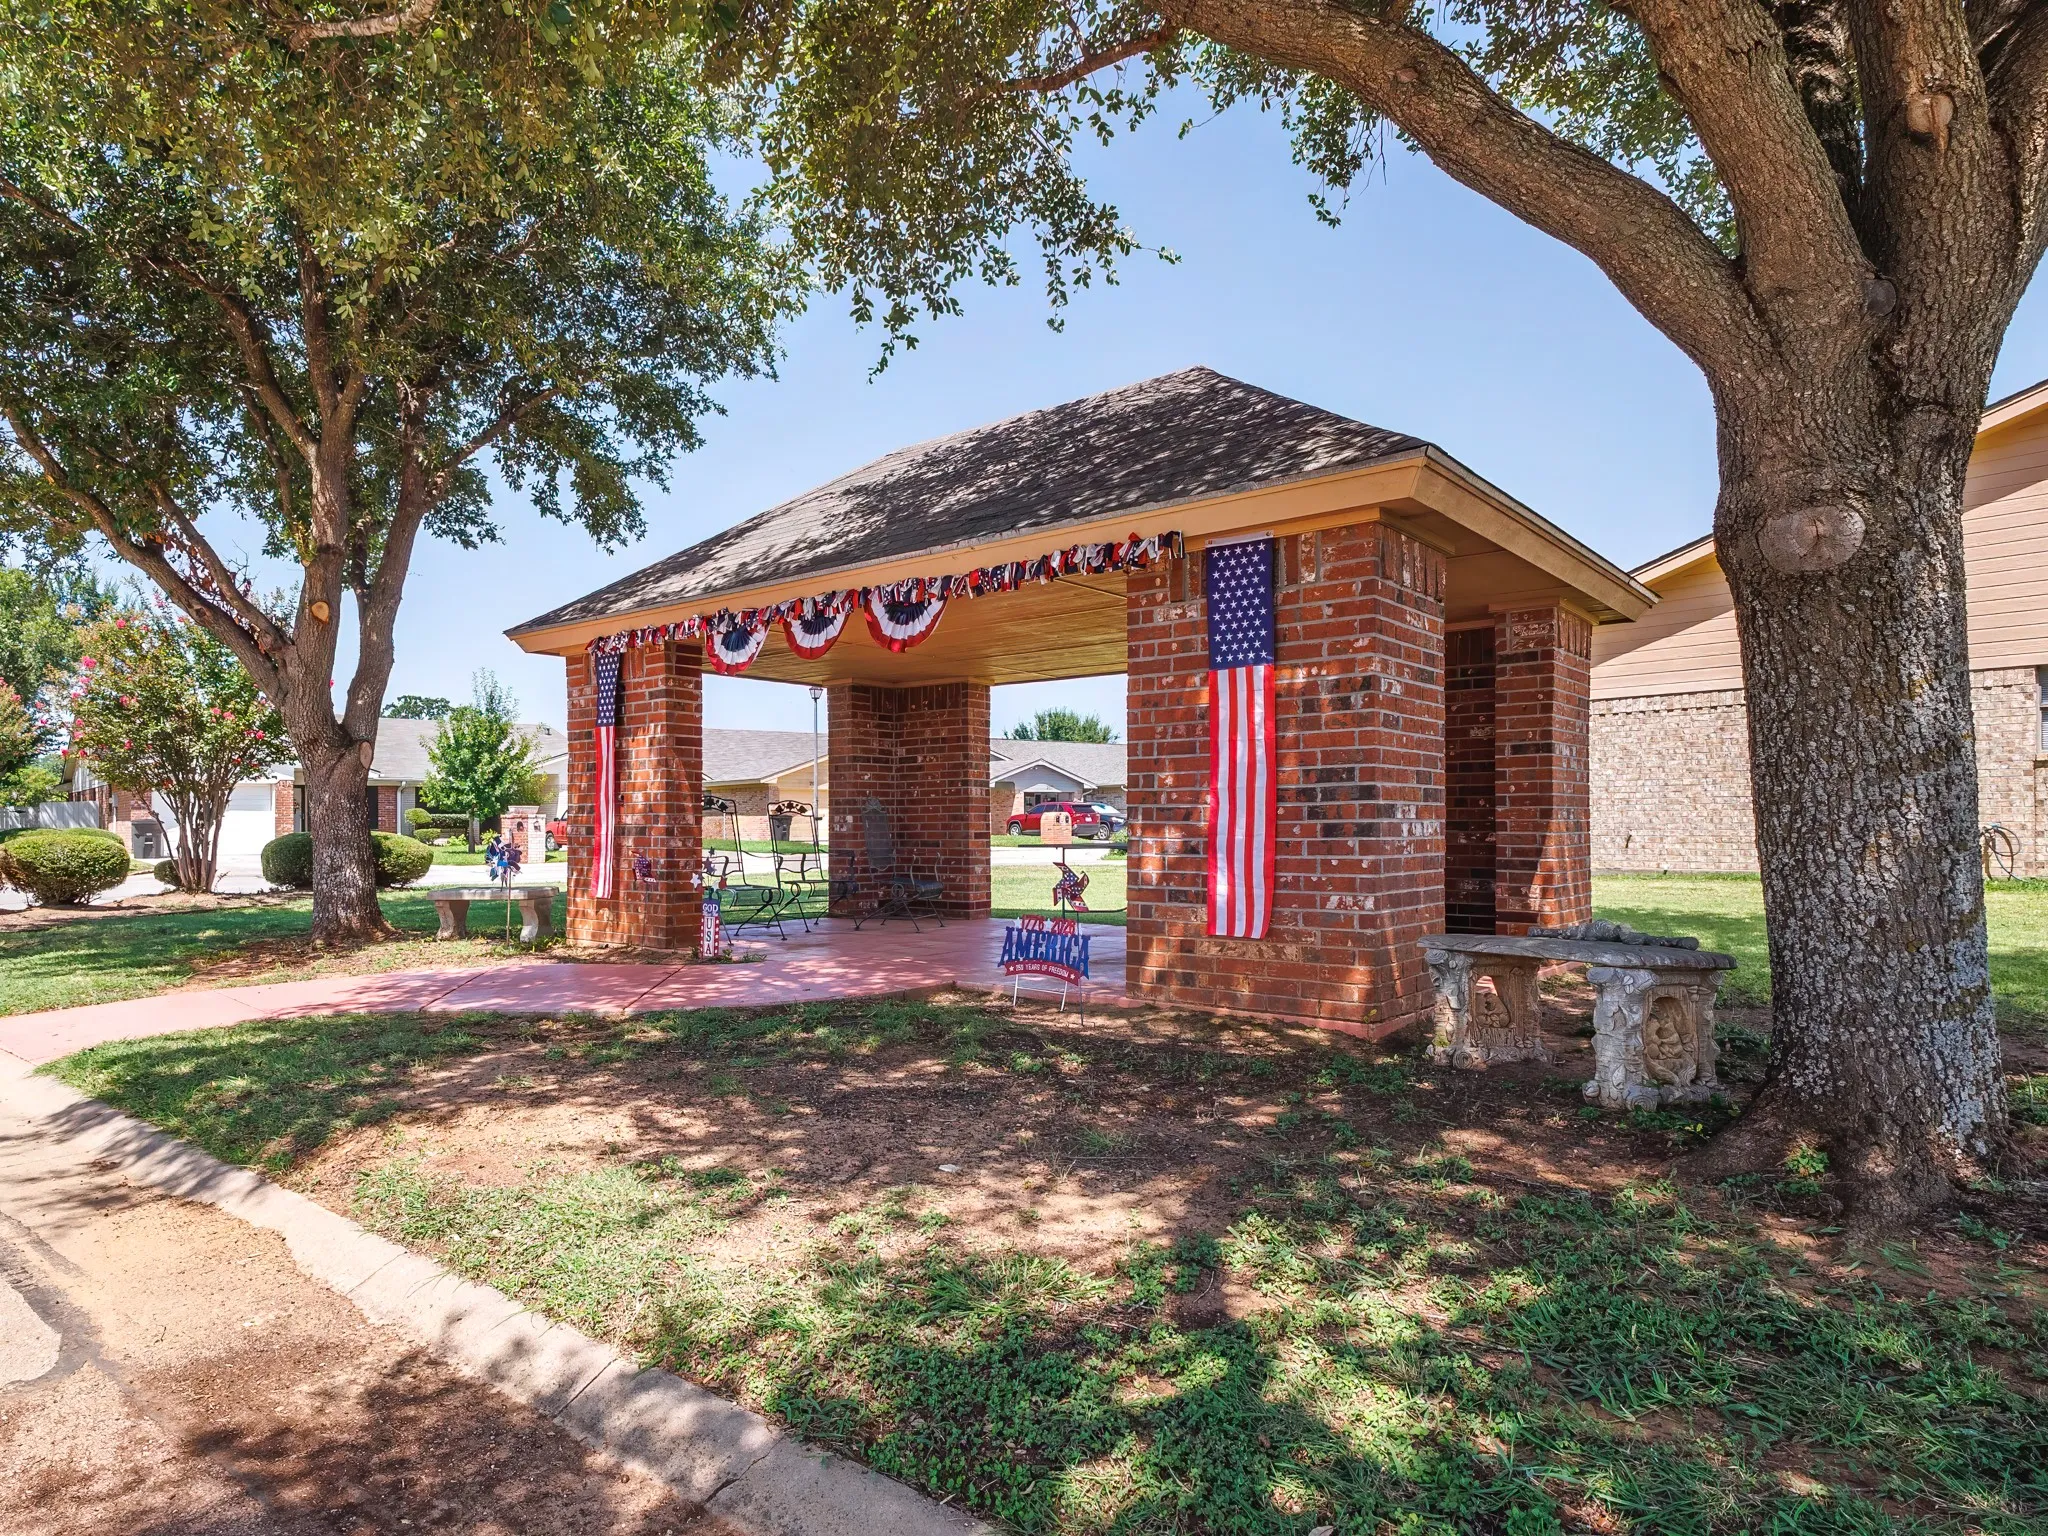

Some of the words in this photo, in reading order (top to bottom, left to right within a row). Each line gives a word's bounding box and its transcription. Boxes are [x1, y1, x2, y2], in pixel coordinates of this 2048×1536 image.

[703, 903, 718, 912] GOD
[1021, 914, 1044, 931] 1776
[997, 926, 1090, 980] AMERICA
[1025, 963, 1040, 971] YEARS
[1048, 965, 1069, 978] FREEDOM
